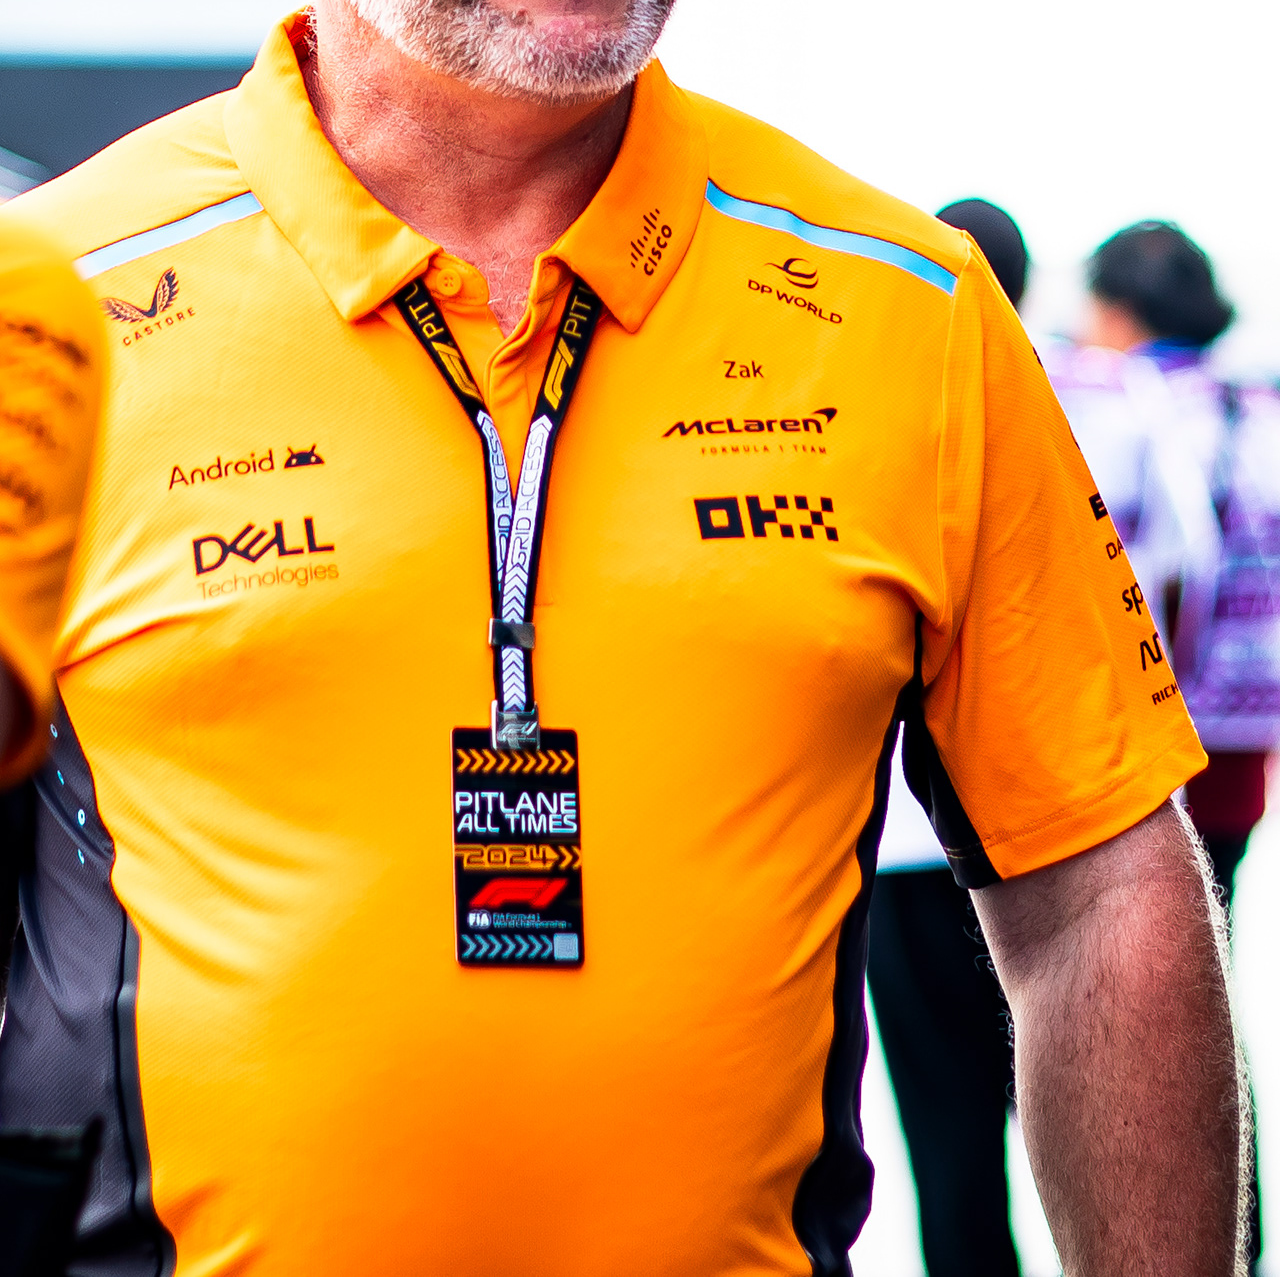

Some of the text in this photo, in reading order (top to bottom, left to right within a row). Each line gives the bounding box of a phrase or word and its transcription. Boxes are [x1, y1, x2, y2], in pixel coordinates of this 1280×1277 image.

[747, 278, 843, 325] DP WORLD
[122, 307, 197, 347] CASTORE
[723, 360, 765, 379] Zak
[661, 415, 826, 439] McLaren
[487, 425, 510, 509] ACCESS
[700, 444, 771, 456] FORMULA
[793, 444, 828, 455] TEAM
[168, 449, 275, 491] Android
[510, 431, 545, 567] GRID ACCESS
[693, 494, 839, 542] OKX
[192, 516, 335, 576] DELL
[196, 562, 340, 601] Technologies
[455, 791, 577, 815] PITLANE
[457, 813, 578, 834] ALL TIMES
[460, 844, 553, 869] 2024
